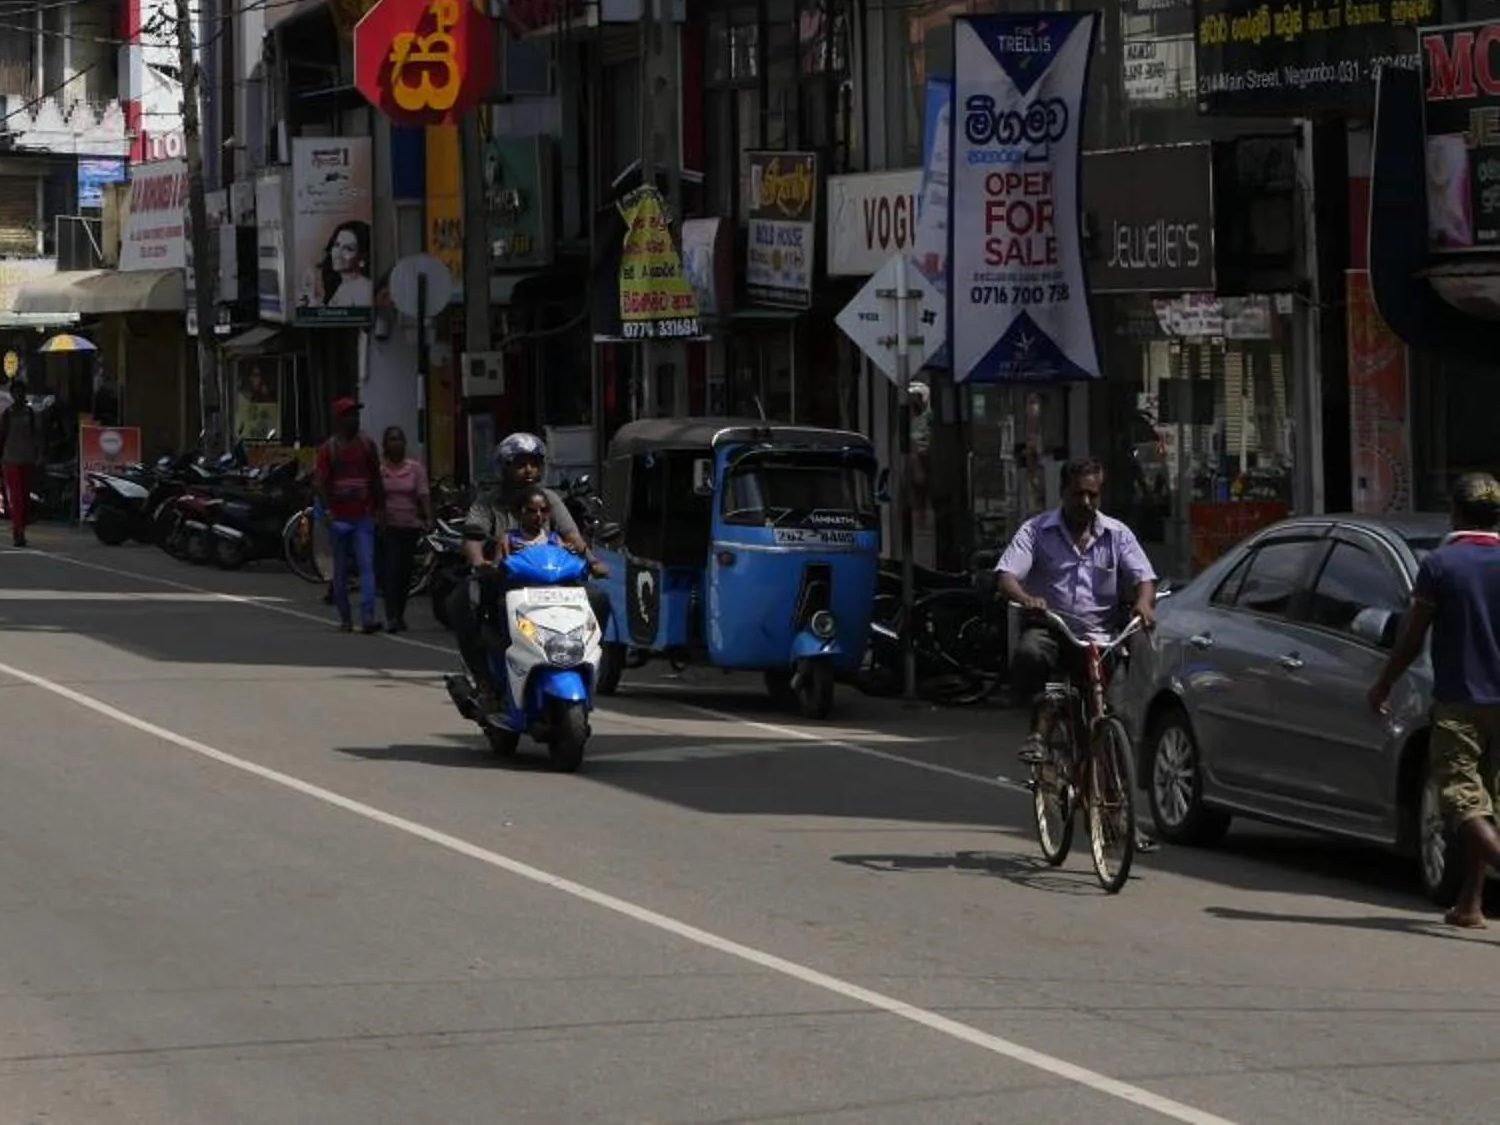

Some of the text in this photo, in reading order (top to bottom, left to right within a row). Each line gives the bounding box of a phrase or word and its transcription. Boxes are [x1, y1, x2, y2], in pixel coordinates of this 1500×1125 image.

[996, 35, 1052, 52] TRELLIS
[985, 200, 1055, 235] FOR
[984, 237, 1059, 266] SALE
